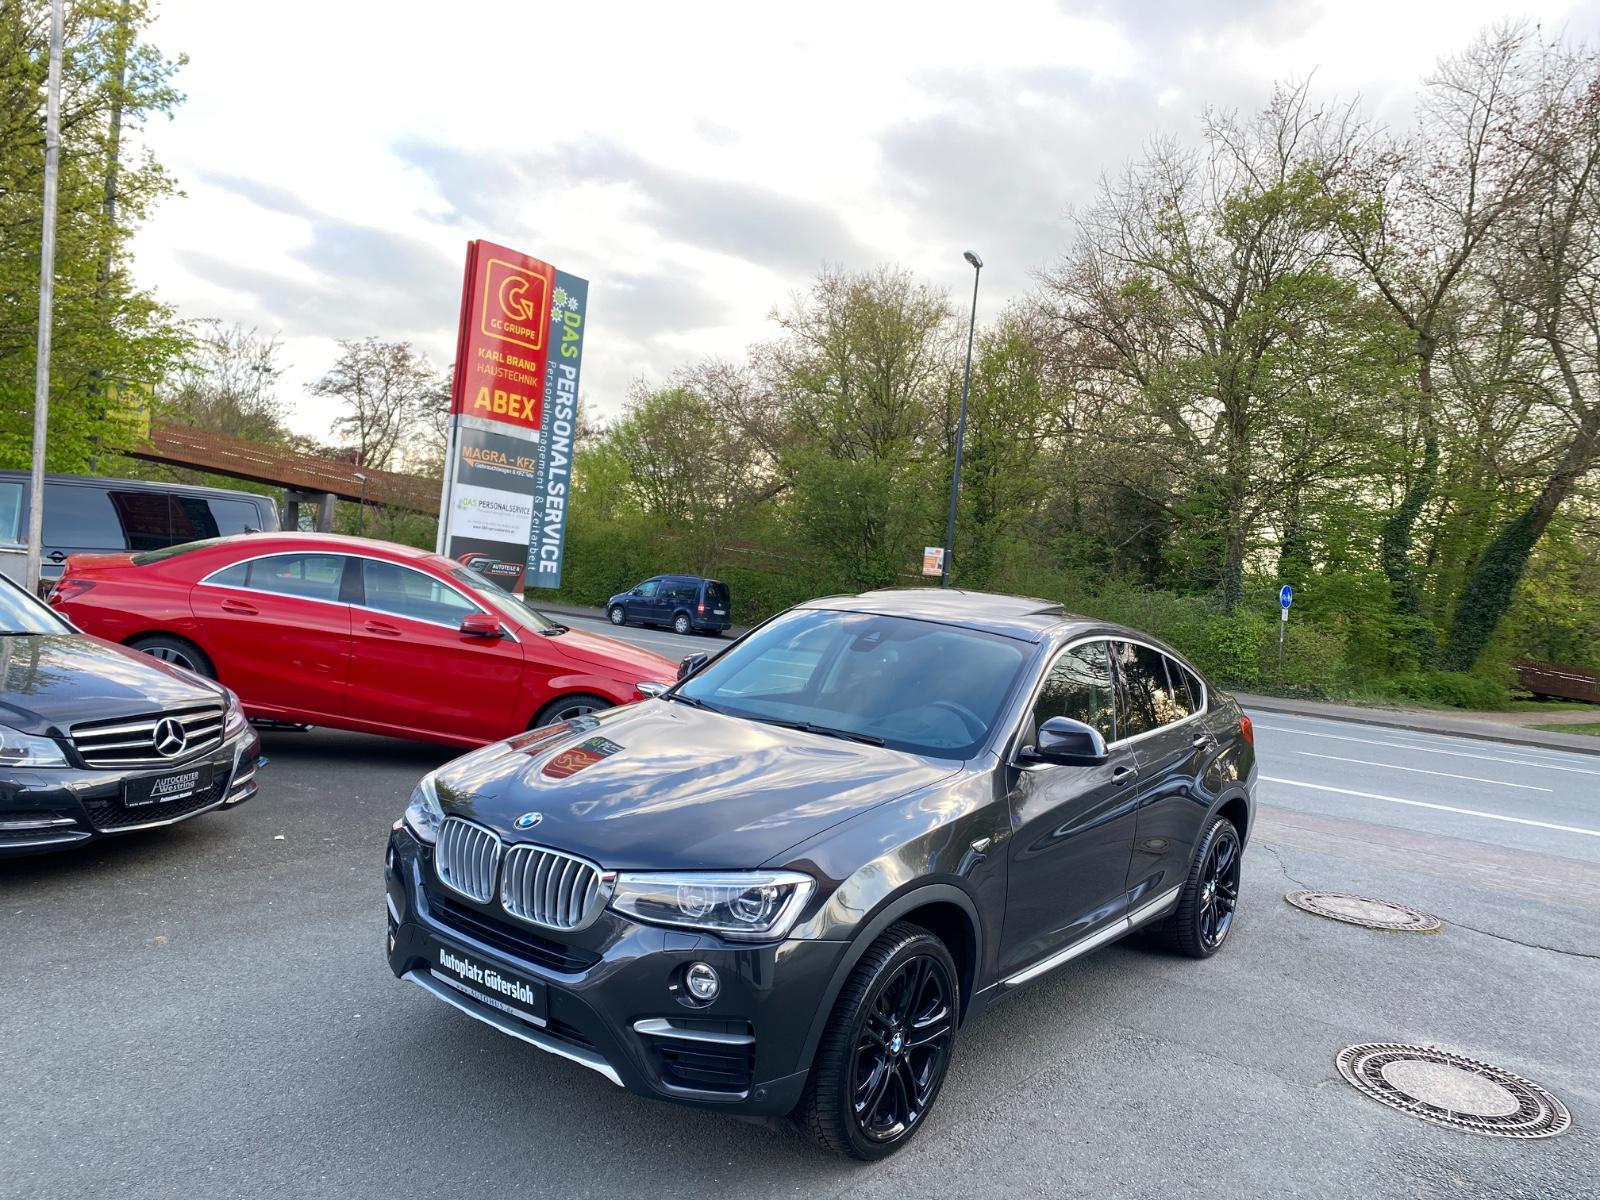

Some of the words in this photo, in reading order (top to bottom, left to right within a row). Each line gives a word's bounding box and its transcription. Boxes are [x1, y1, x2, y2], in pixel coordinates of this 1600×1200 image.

[490, 318, 502, 330] GC
[503, 321, 536, 340] GRUPPE
[560, 310, 582, 359] DAS
[478, 347, 505, 364] KARL
[506, 354, 537, 372] BRAND
[476, 363, 538, 387] HAUSTECHNIK
[473, 386, 536, 422] ABEX
[536, 360, 557, 489] Personalmanagement
[461, 445, 508, 465] MAGRA
[516, 455, 536, 471] KFZ
[539, 363, 577, 574] PERSONALSERVICE
[478, 499, 531, 517] PERSONALSERVICE
[528, 509, 544, 571] Zeitarbeit
[150, 771, 199, 797] AUTOCENTER
[160, 780, 195, 793] Westring
[440, 948, 484, 984] Autoplatz
[484, 969, 534, 1005] Gütersloh
